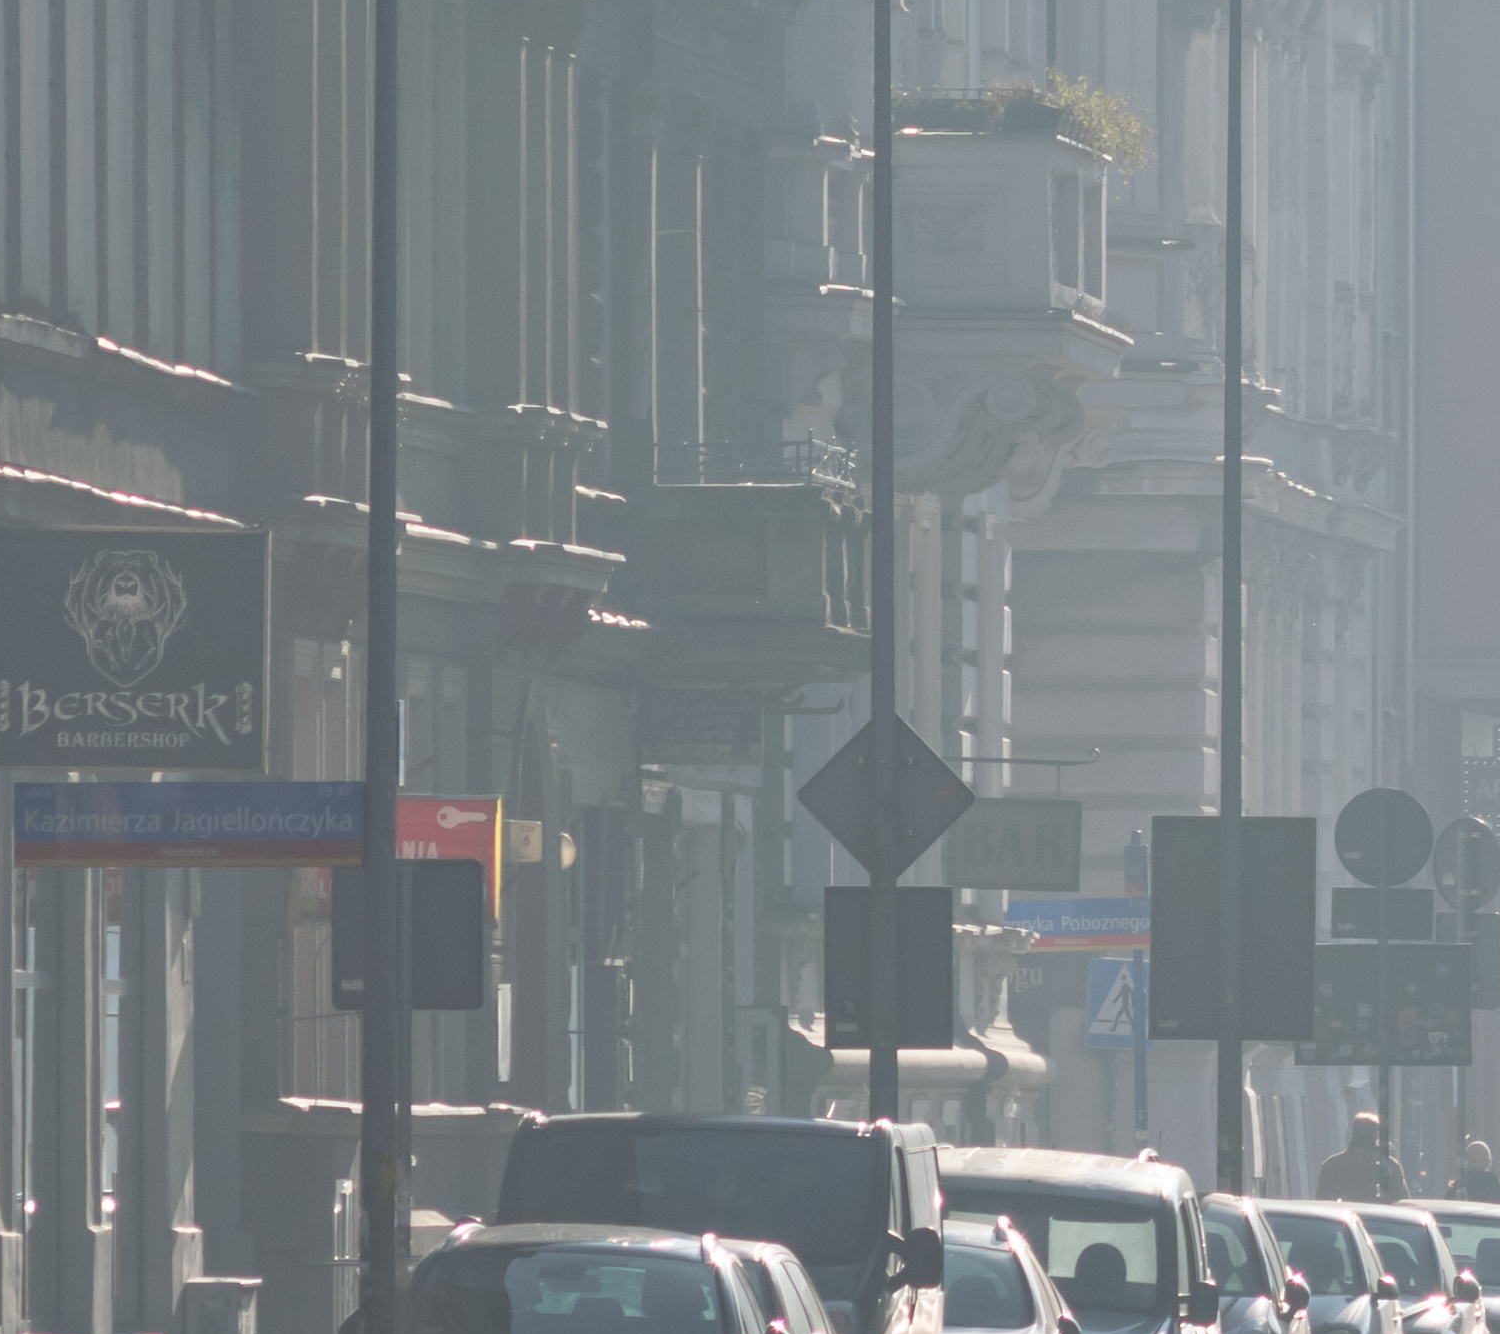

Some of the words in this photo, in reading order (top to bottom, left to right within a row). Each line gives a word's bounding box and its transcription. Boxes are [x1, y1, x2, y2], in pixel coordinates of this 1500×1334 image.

[15, 680, 231, 745] BERSERK
[57, 731, 190, 748] BARBERSHOP
[24, 808, 160, 833] Kazimierza
[170, 807, 353, 839] Jagiellończyka
[396, 840, 438, 858] NIA
[1061, 914, 1150, 933] Pobożnego
